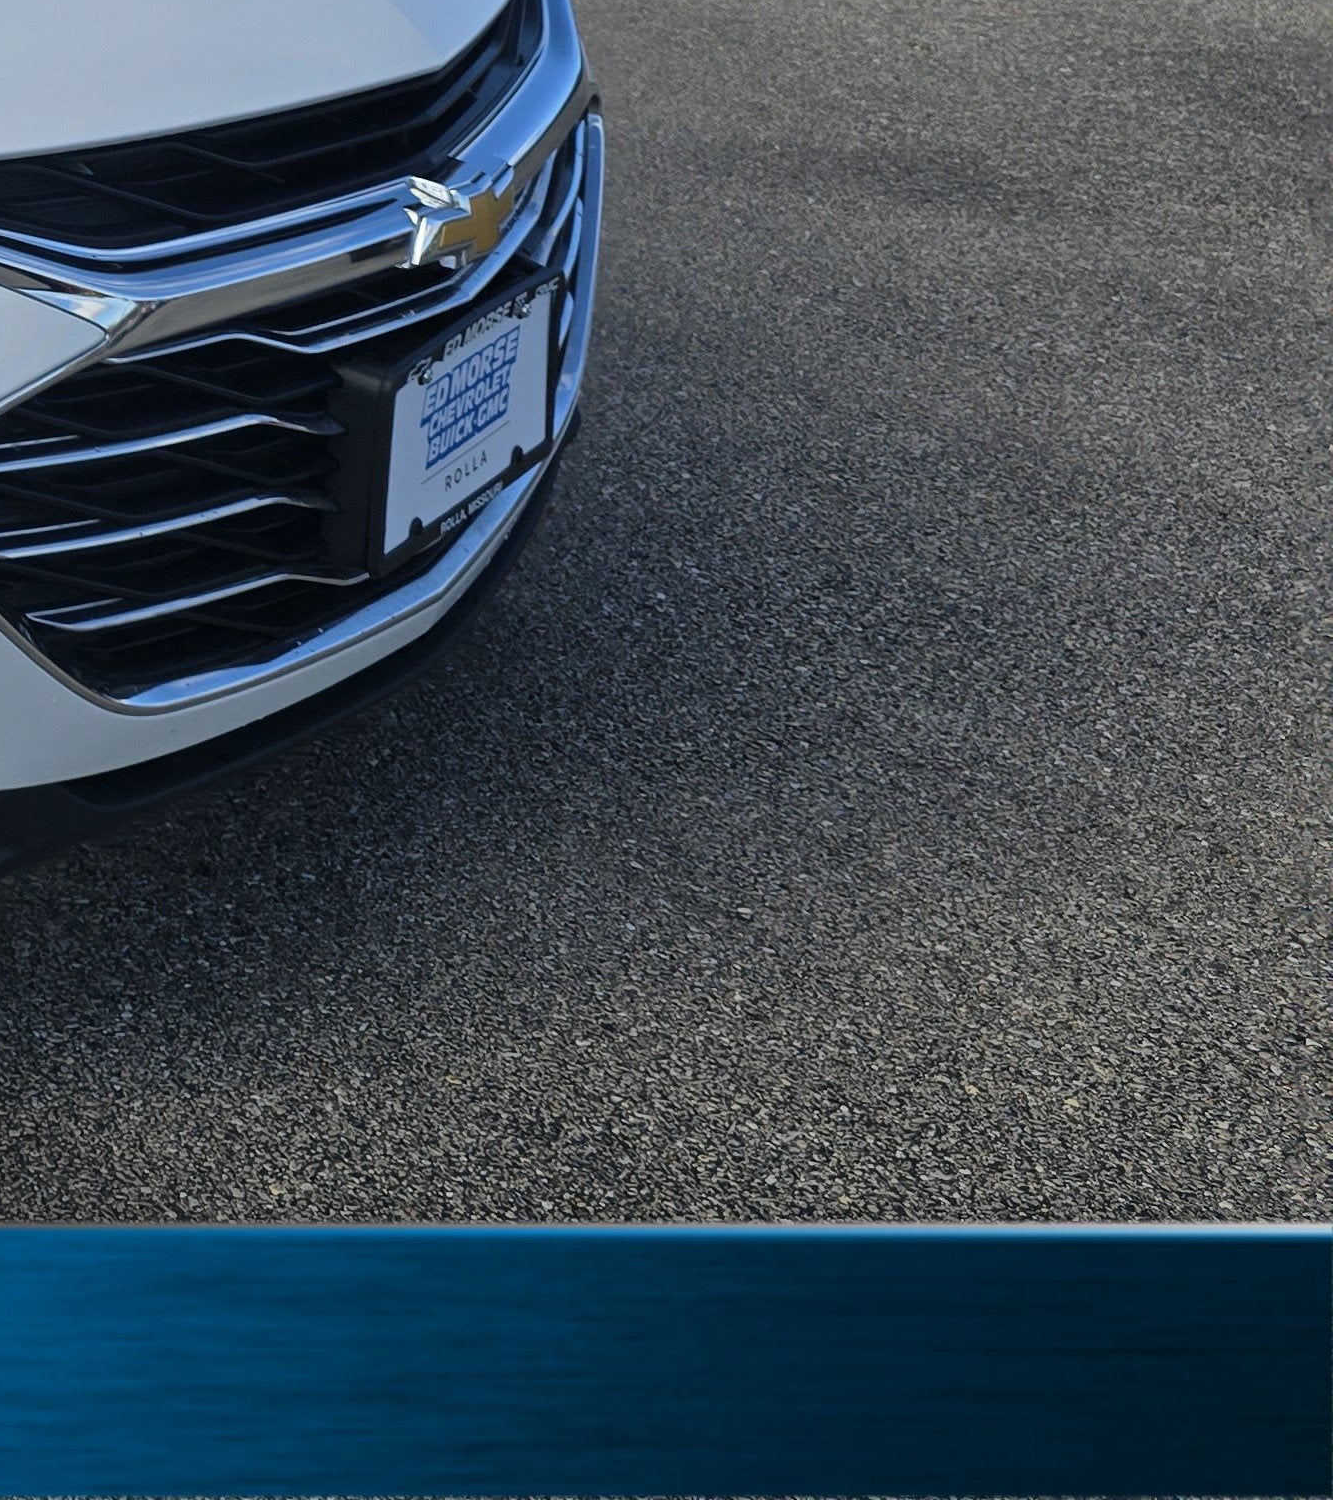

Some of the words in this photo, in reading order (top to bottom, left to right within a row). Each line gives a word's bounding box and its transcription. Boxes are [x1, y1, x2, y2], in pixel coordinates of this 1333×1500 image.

[422, 375, 450, 421] ED
[448, 327, 519, 401] MORSE
[444, 449, 488, 492] ROLLA
